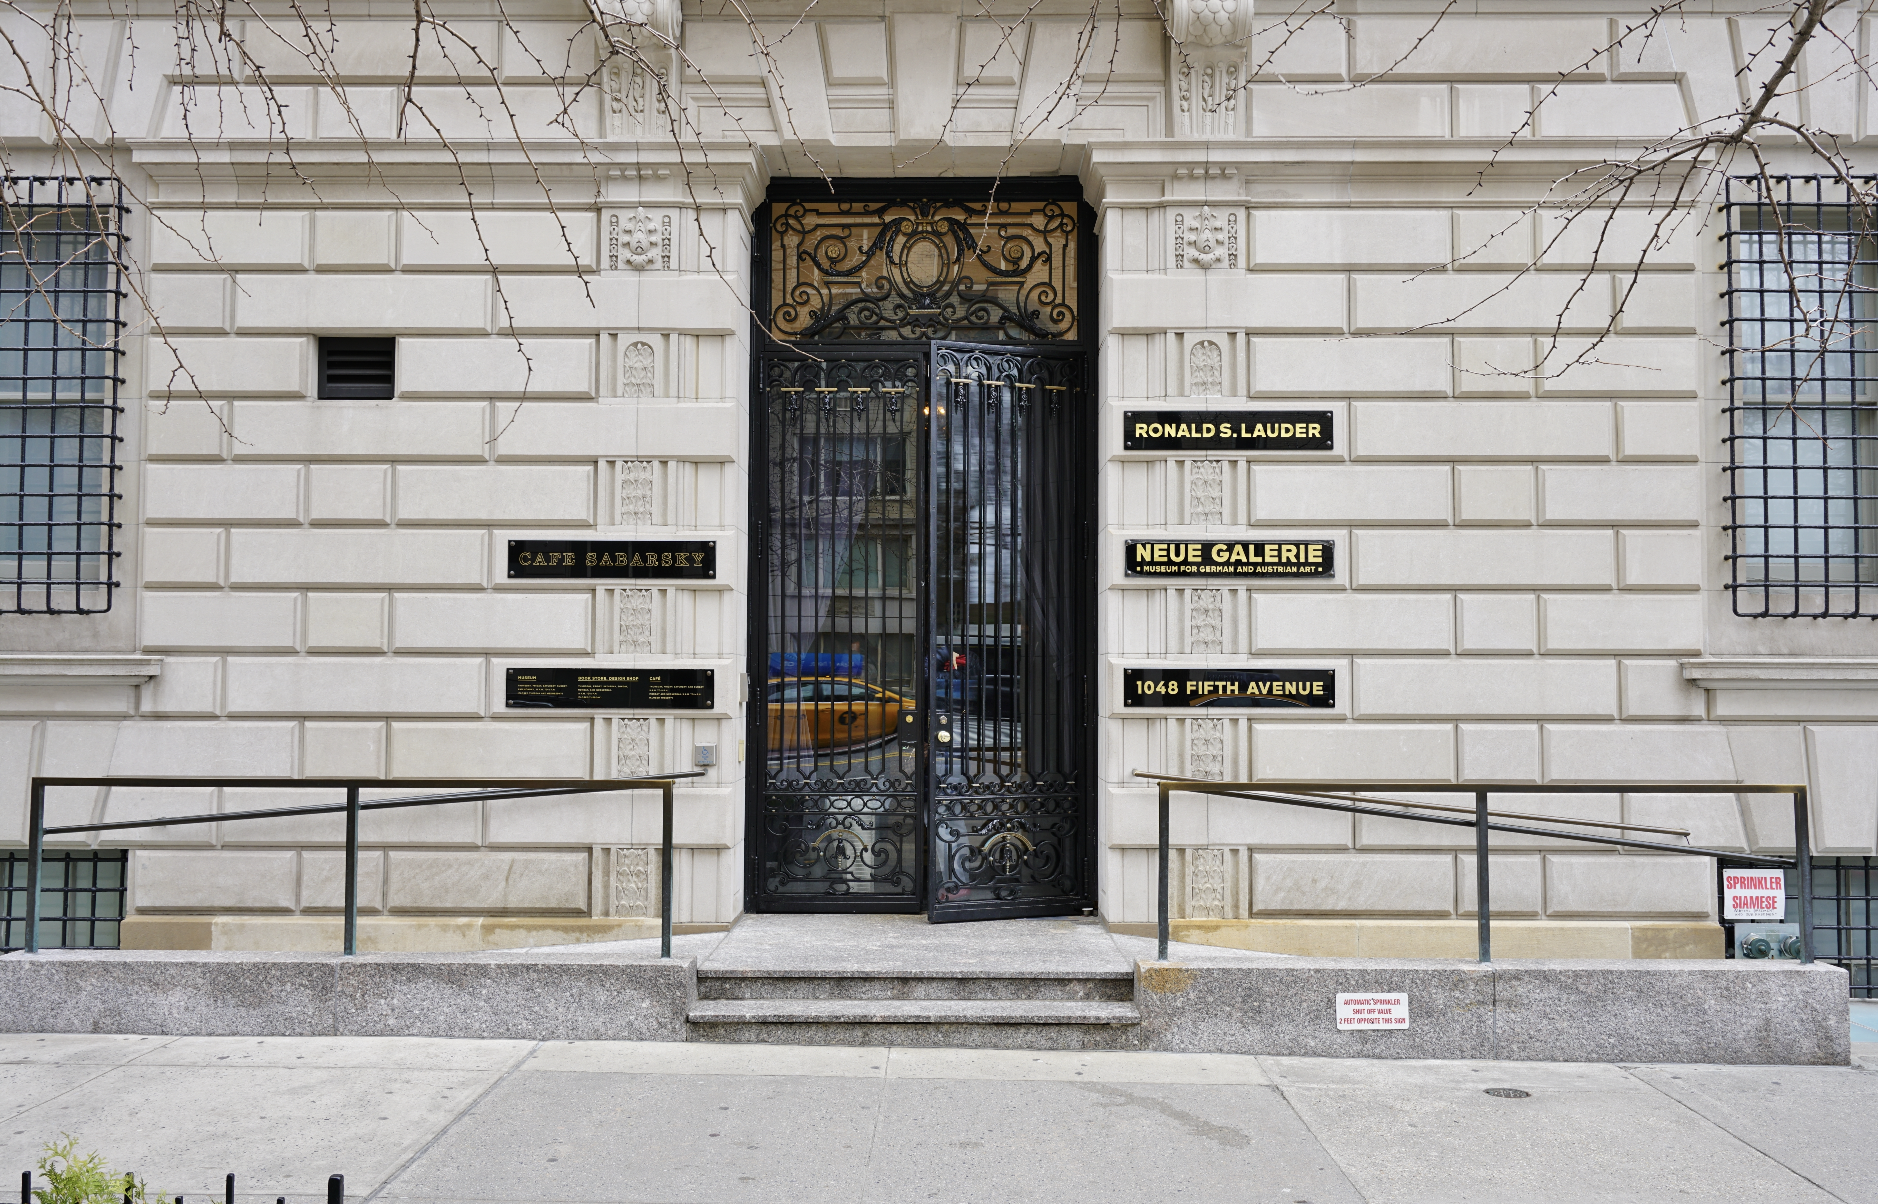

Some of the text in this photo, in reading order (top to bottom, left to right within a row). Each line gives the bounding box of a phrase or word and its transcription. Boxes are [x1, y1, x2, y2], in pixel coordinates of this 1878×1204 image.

[1135, 423, 1322, 438] RONALD S. LAUDER
[518, 552, 705, 567] CAFE SABARSKY
[1136, 543, 1323, 563] NEUE GALERIE
[1143, 565, 1316, 573] MUSEUM FOR GERMAN AND AUSTRIAN ART
[1136, 680, 1324, 695] 1048 FIFTH AVENUE
[1726, 875, 1782, 890] SPRINKLER
[1732, 895, 1778, 910] SIAMESE
[1343, 998, 1401, 1006] AUTOMATIC SPRINKLER
[1382, 1017, 1393, 1025] THIS
[1393, 1017, 1406, 1025] SIGN
